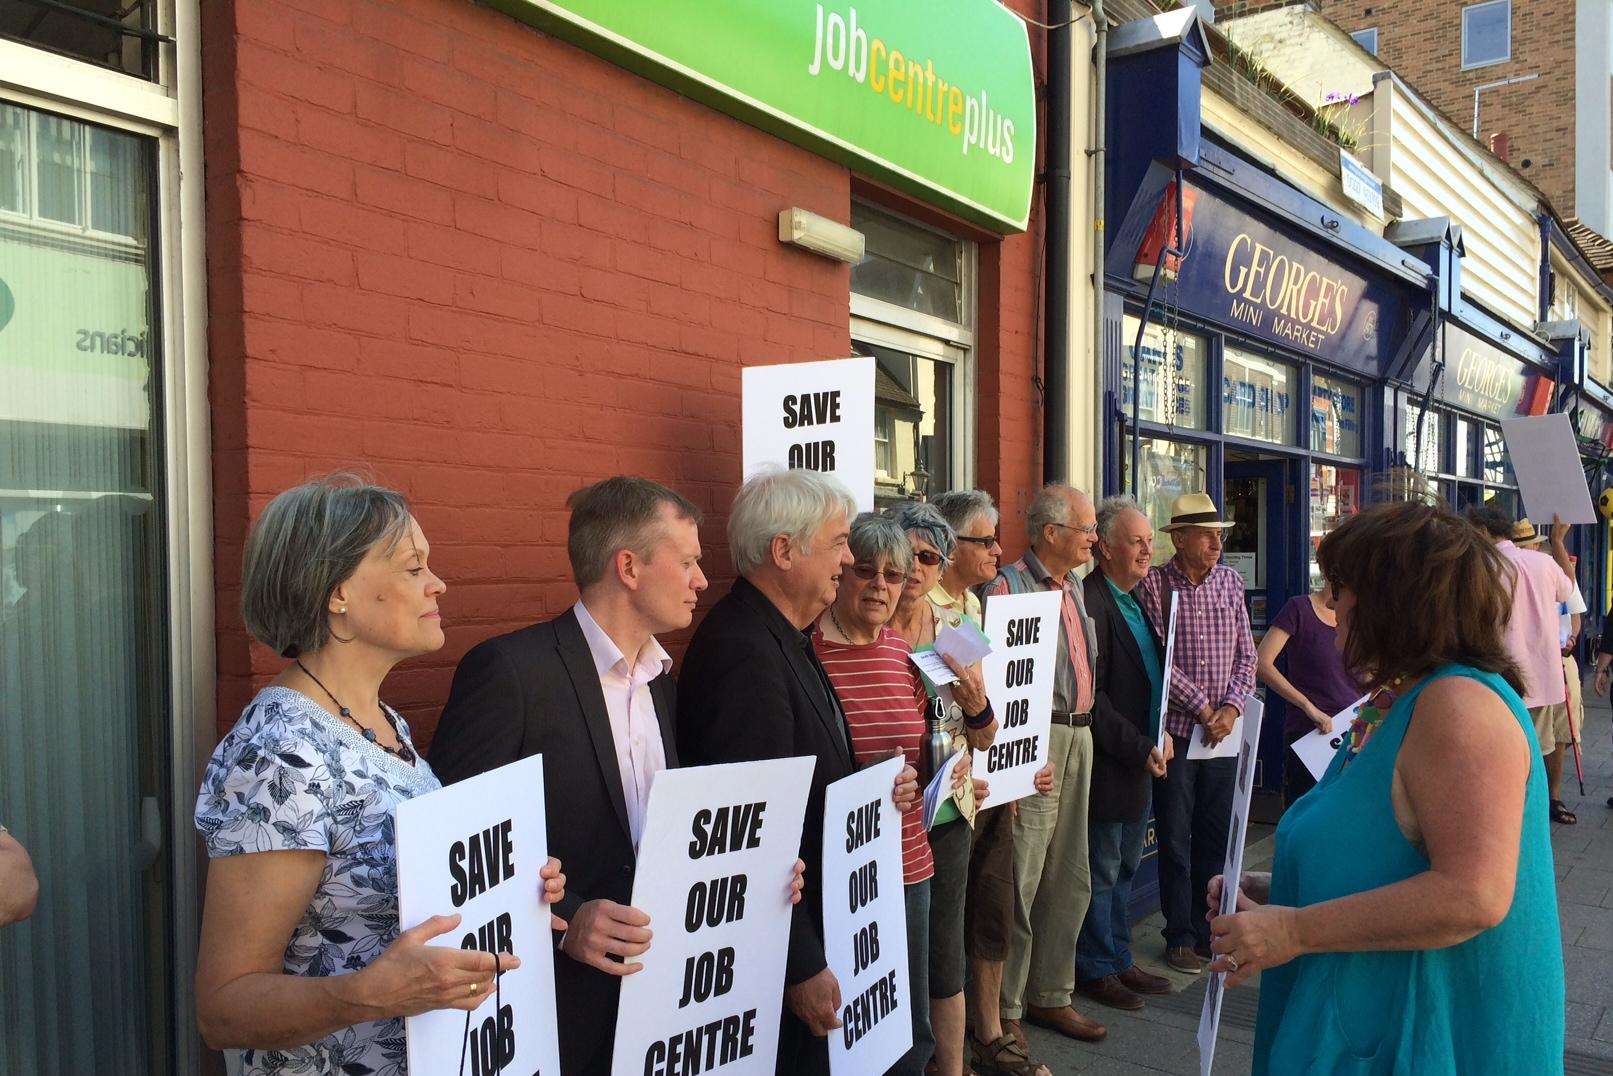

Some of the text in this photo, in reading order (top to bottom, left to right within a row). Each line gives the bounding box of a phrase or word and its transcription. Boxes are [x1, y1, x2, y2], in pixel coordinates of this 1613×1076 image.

[1224, 233, 1348, 335] GEORGE'S
[1230, 299, 1325, 349] MINI MARKET
[782, 390, 841, 429] SAVE
[788, 440, 836, 472] OUR
[1006, 616, 1041, 648] SAVE
[1005, 657, 1034, 689] OUR
[1003, 698, 1029, 730] JOB
[987, 735, 1039, 774] CENTRE
[688, 801, 767, 860] SAVE
[845, 798, 881, 854] SAVE
[449, 818, 515, 908] SAVE
[848, 859, 879, 914] OUR
[684, 873, 748, 934] OUR
[853, 920, 880, 977] JOB
[678, 946, 735, 1009] JOB
[843, 968, 898, 1051] CENTRE
[643, 1008, 757, 1076] CENTRE
